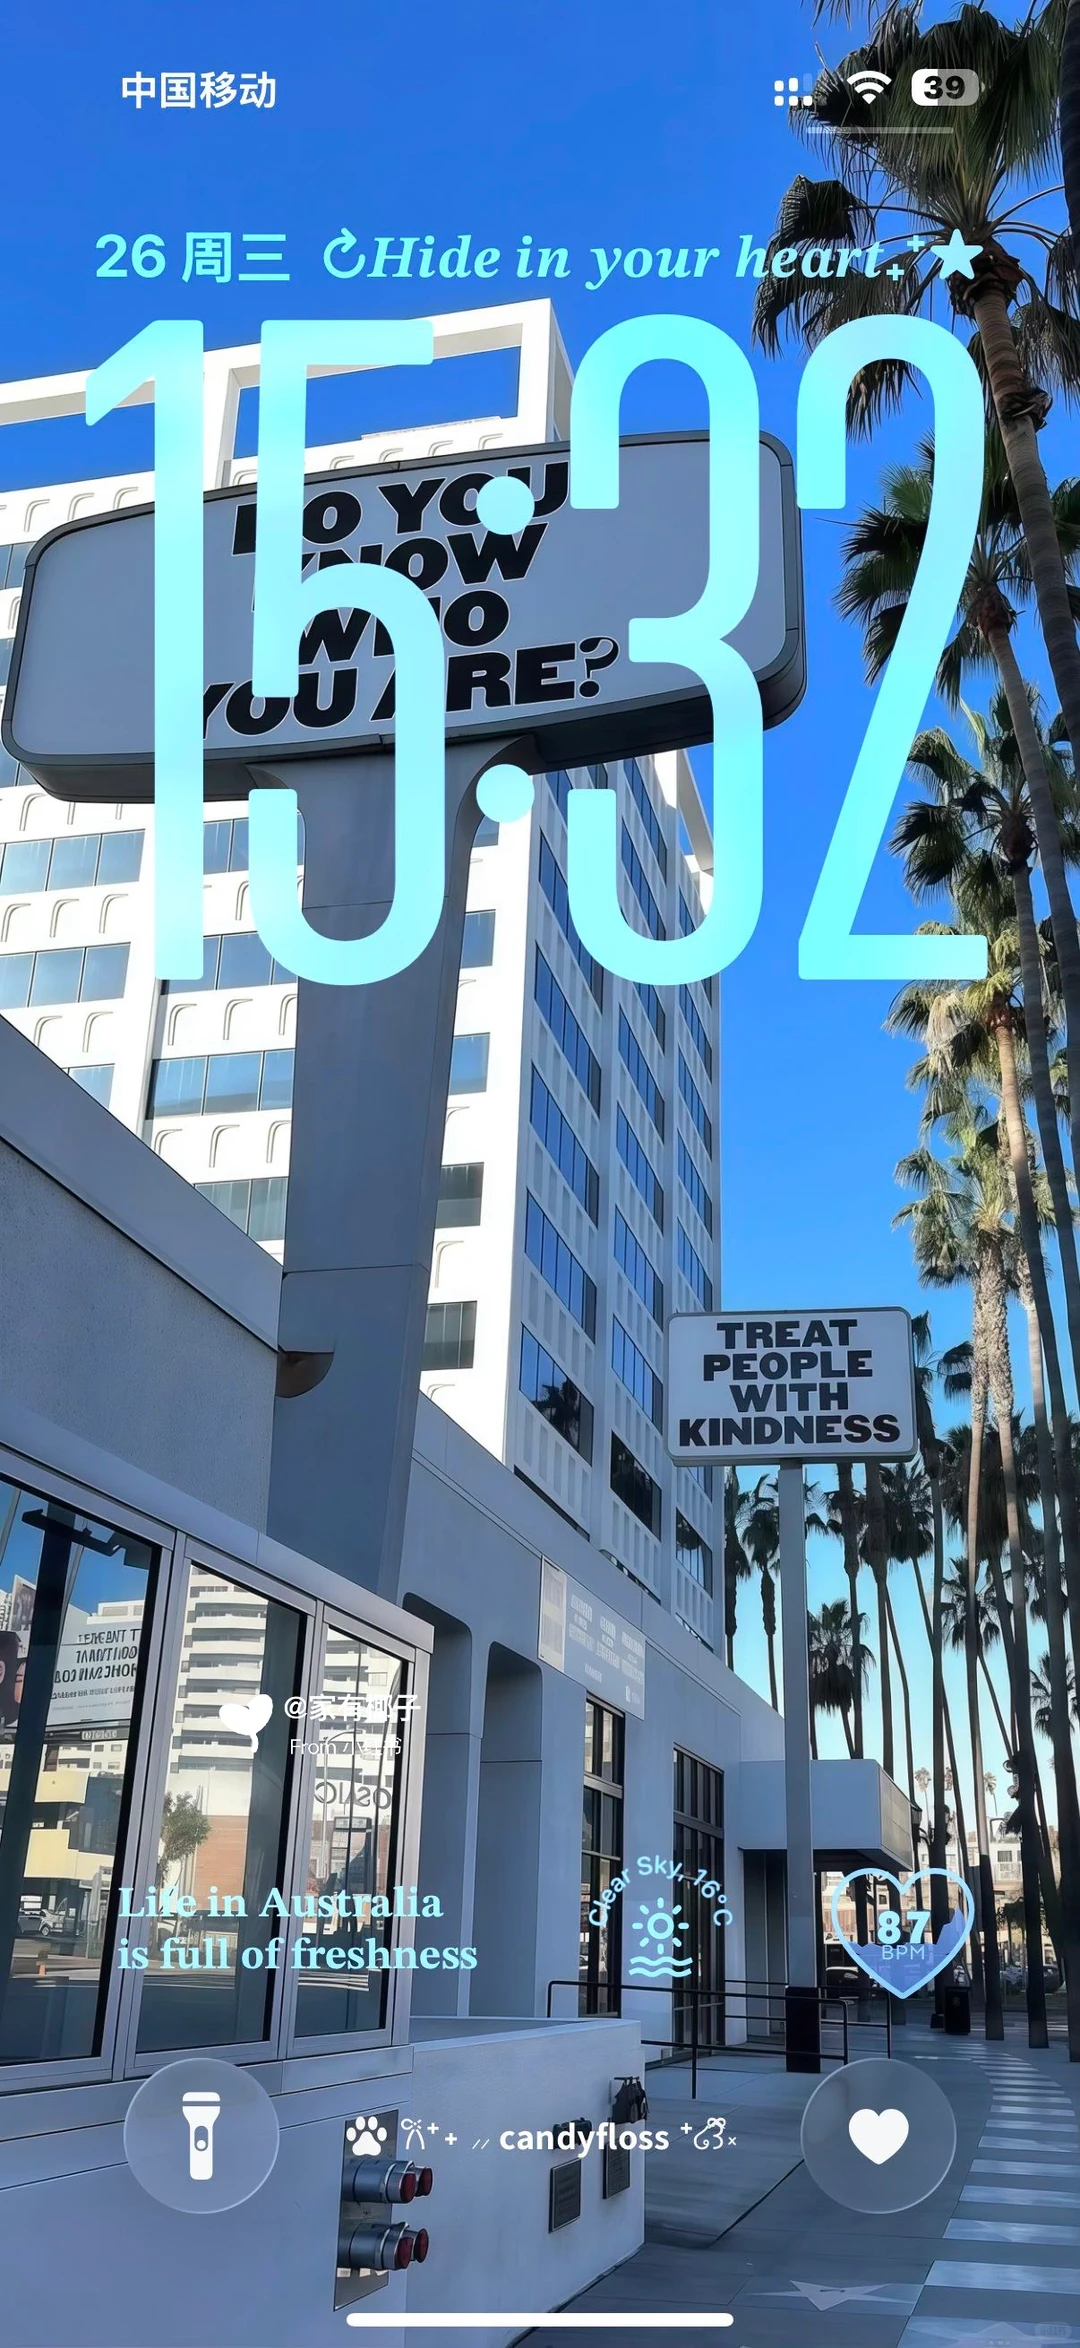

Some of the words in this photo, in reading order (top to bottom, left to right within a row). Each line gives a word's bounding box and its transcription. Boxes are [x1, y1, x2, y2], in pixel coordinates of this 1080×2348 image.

[252, 522, 549, 611] OW
[296, 589, 511, 668] WO
[716, 1319, 858, 1350] TREAT
[703, 1350, 873, 1382] PEOPLE
[729, 1382, 849, 1413] WITH
[679, 1414, 901, 1447] KINDNESS
